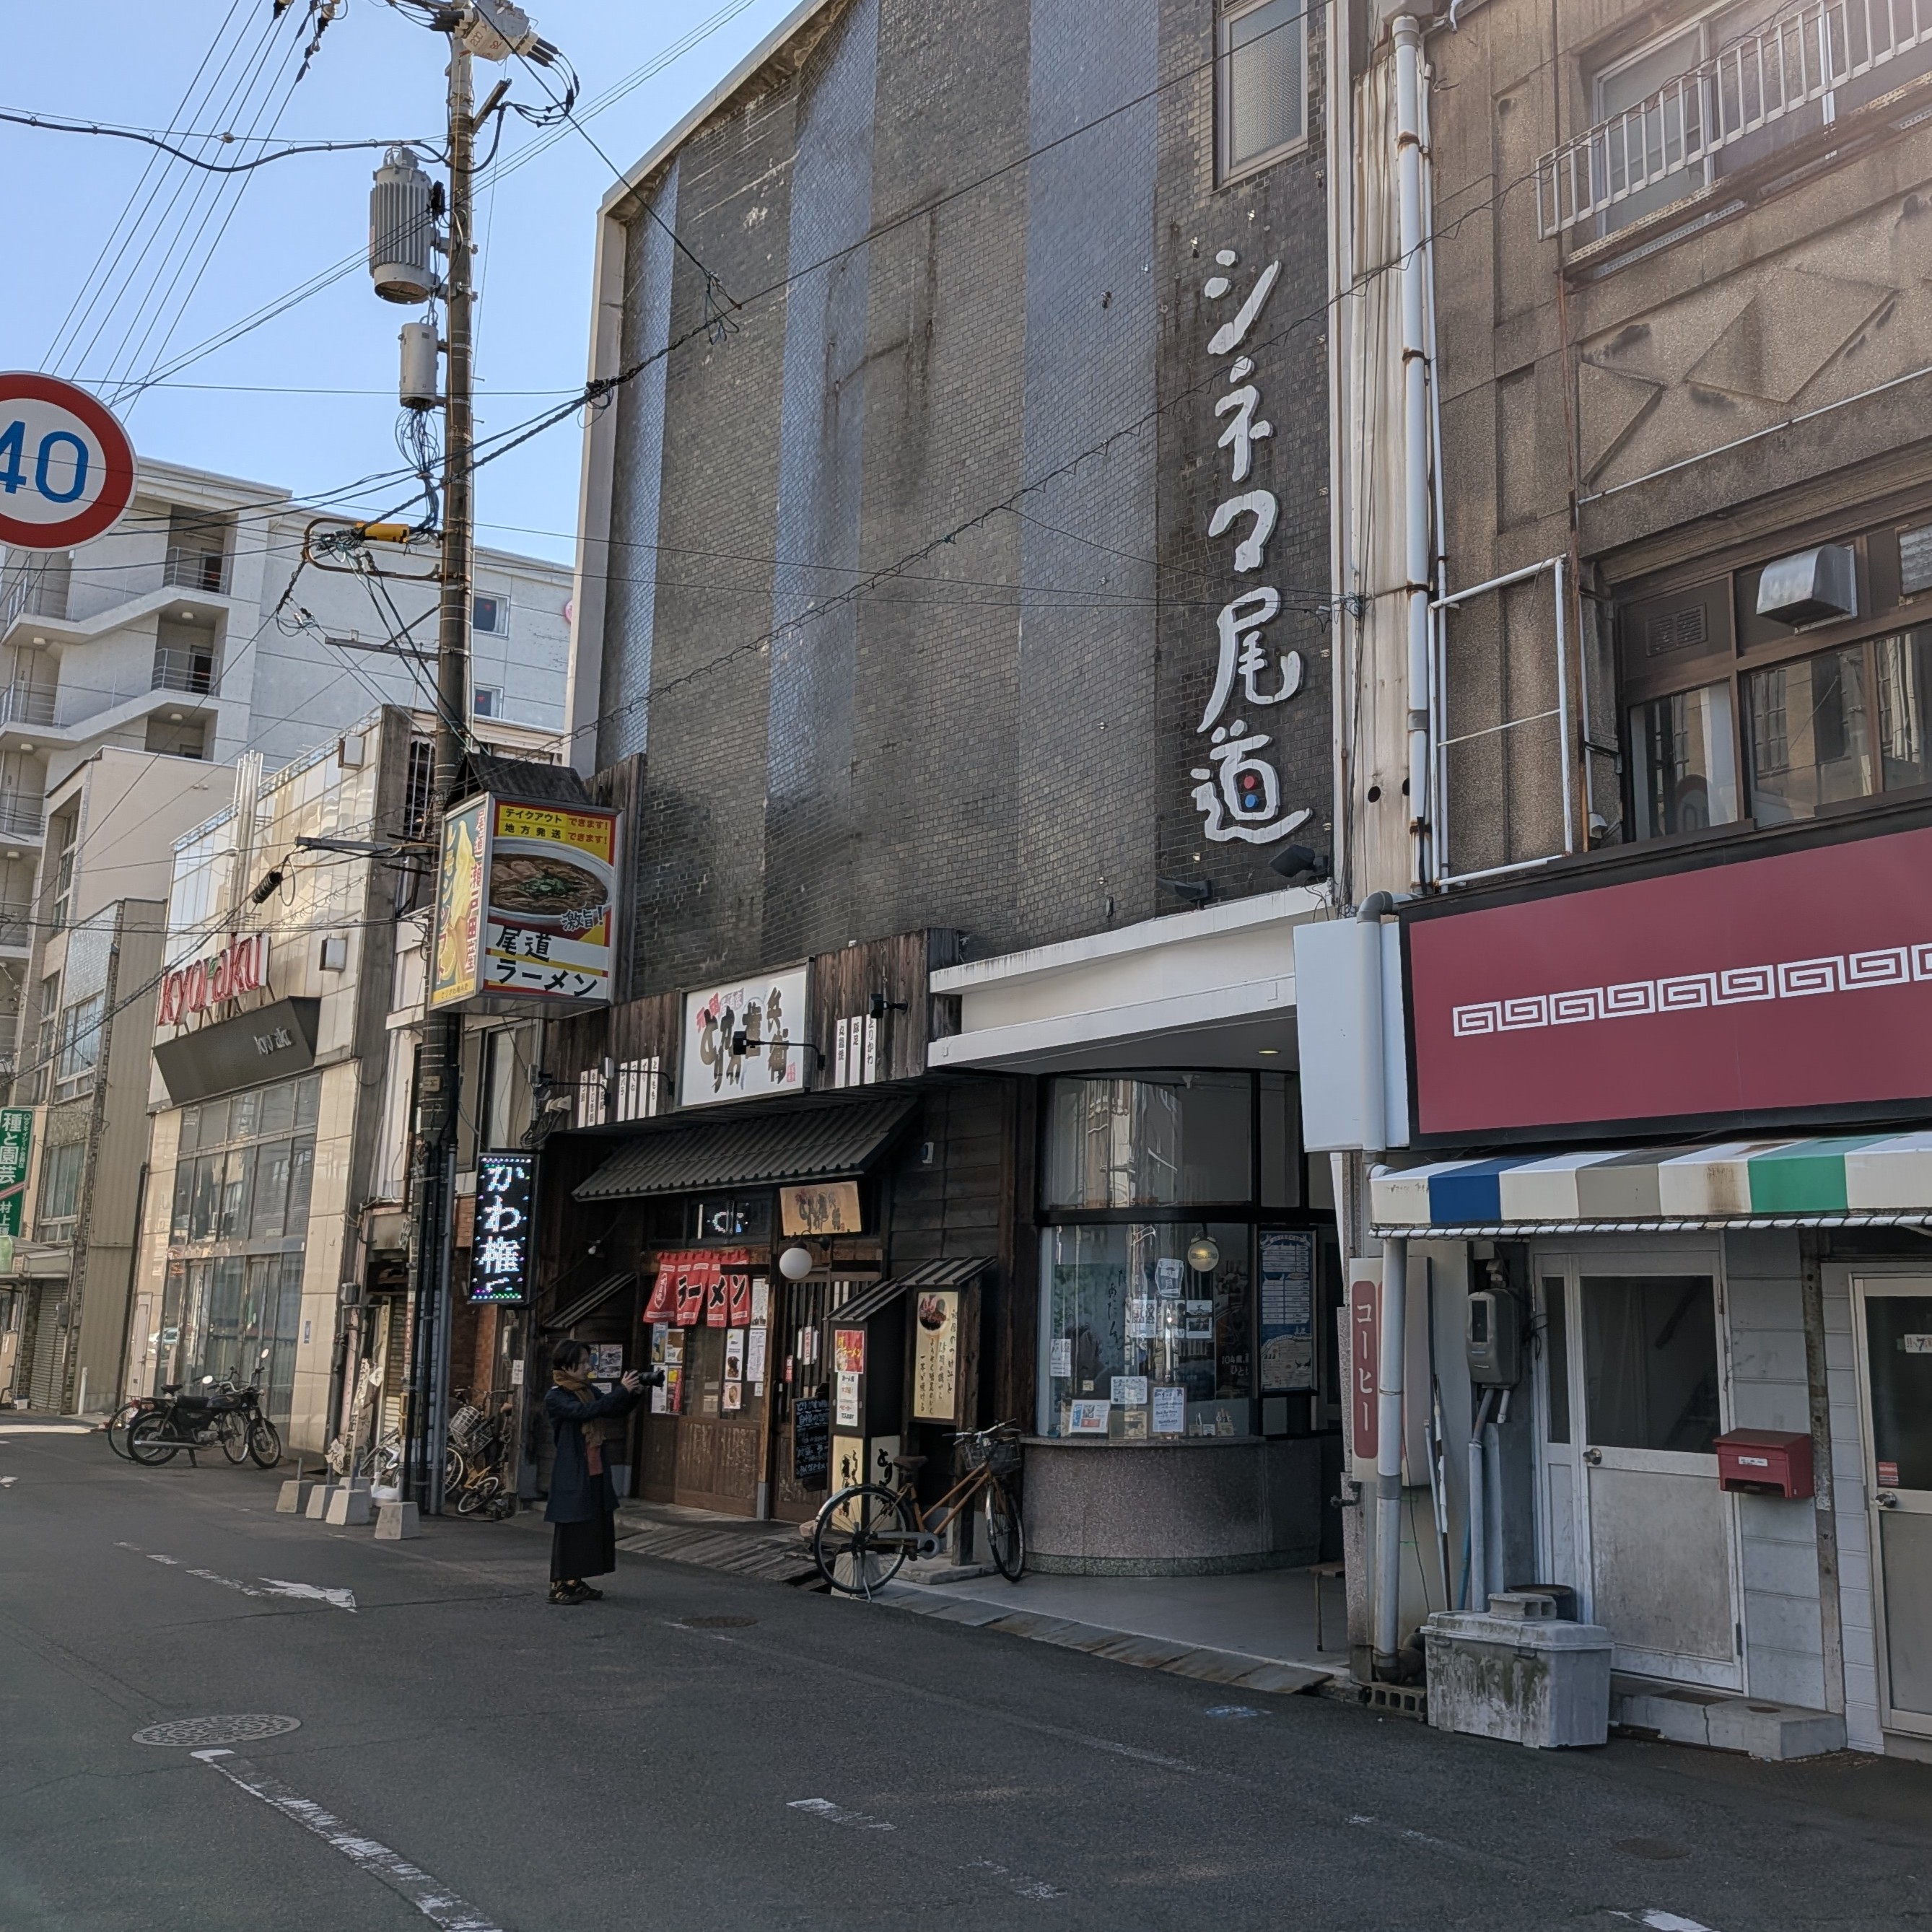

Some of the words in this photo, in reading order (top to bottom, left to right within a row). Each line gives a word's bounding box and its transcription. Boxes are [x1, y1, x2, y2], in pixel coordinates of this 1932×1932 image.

[0, 421, 89, 503] 40
[1191, 250, 1312, 844] シネマ尾道
[504, 823, 561, 839] 地方発送
[505, 808, 562, 823] テイクアウト
[496, 927, 552, 962] 尾道
[496, 958, 598, 997] ラーメン
[0, 1112, 22, 1184] 種と園芸
[677, 1274, 747, 1309] ラーメン
[1357, 1303, 1373, 1431] コーヒー
